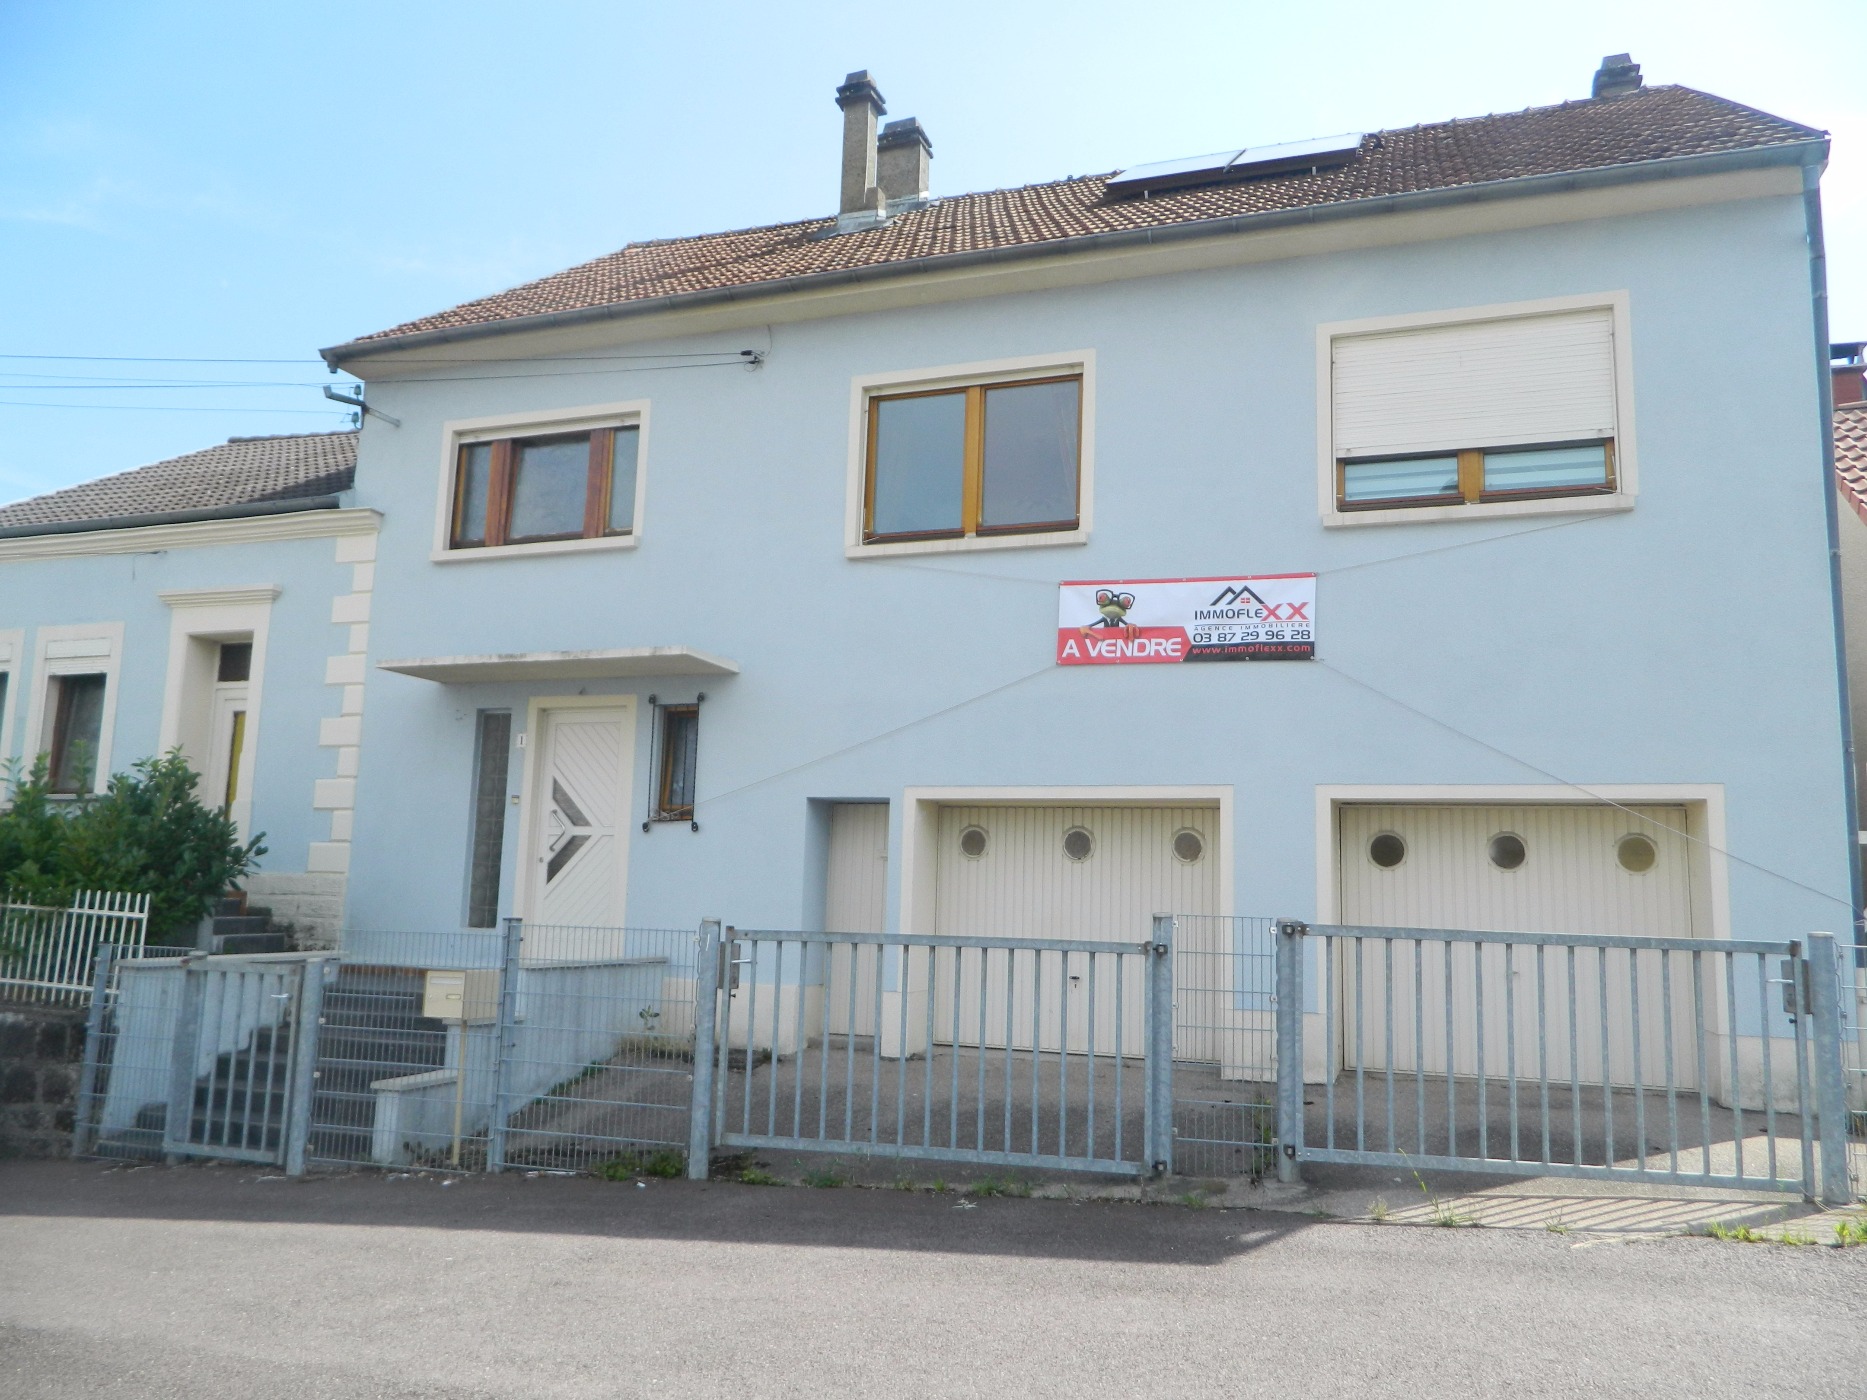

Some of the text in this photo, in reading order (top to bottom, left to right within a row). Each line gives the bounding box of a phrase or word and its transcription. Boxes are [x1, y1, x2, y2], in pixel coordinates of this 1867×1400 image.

[1194, 602, 1309, 621] IMMOFLEXX
[1240, 622, 1310, 630] IMMOBILIERE
[1193, 629, 1311, 643] 03 87 29 96 28
[1061, 637, 1182, 658] A VENDRE
[1192, 644, 1311, 654] www.immoflexx.com
